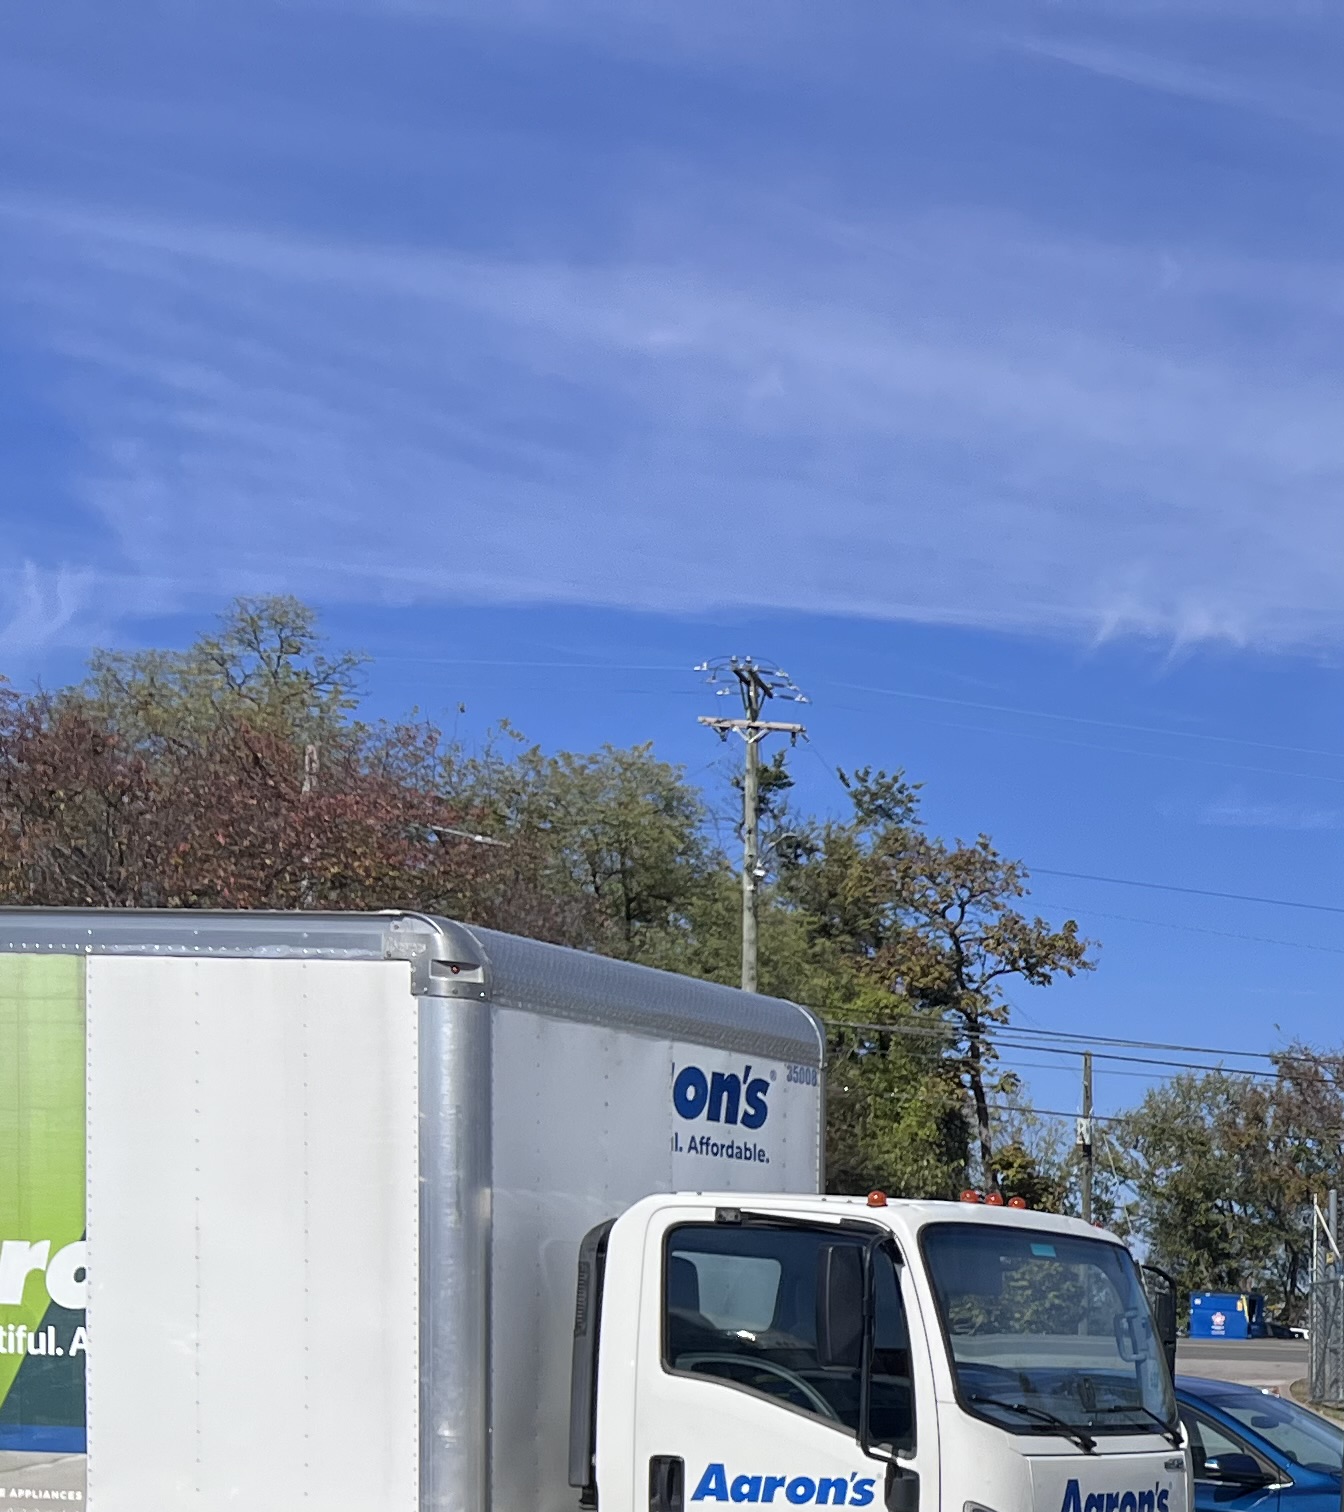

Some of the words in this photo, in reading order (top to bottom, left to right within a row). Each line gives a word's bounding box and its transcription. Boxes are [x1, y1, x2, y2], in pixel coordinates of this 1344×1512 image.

[786, 1065, 818, 1087] 35008
[671, 1062, 770, 1130] on's
[687, 1135, 770, 1164] Affordable.
[9, 1488, 83, 1501] APPLIANCES
[691, 1463, 876, 1506] Aaron's
